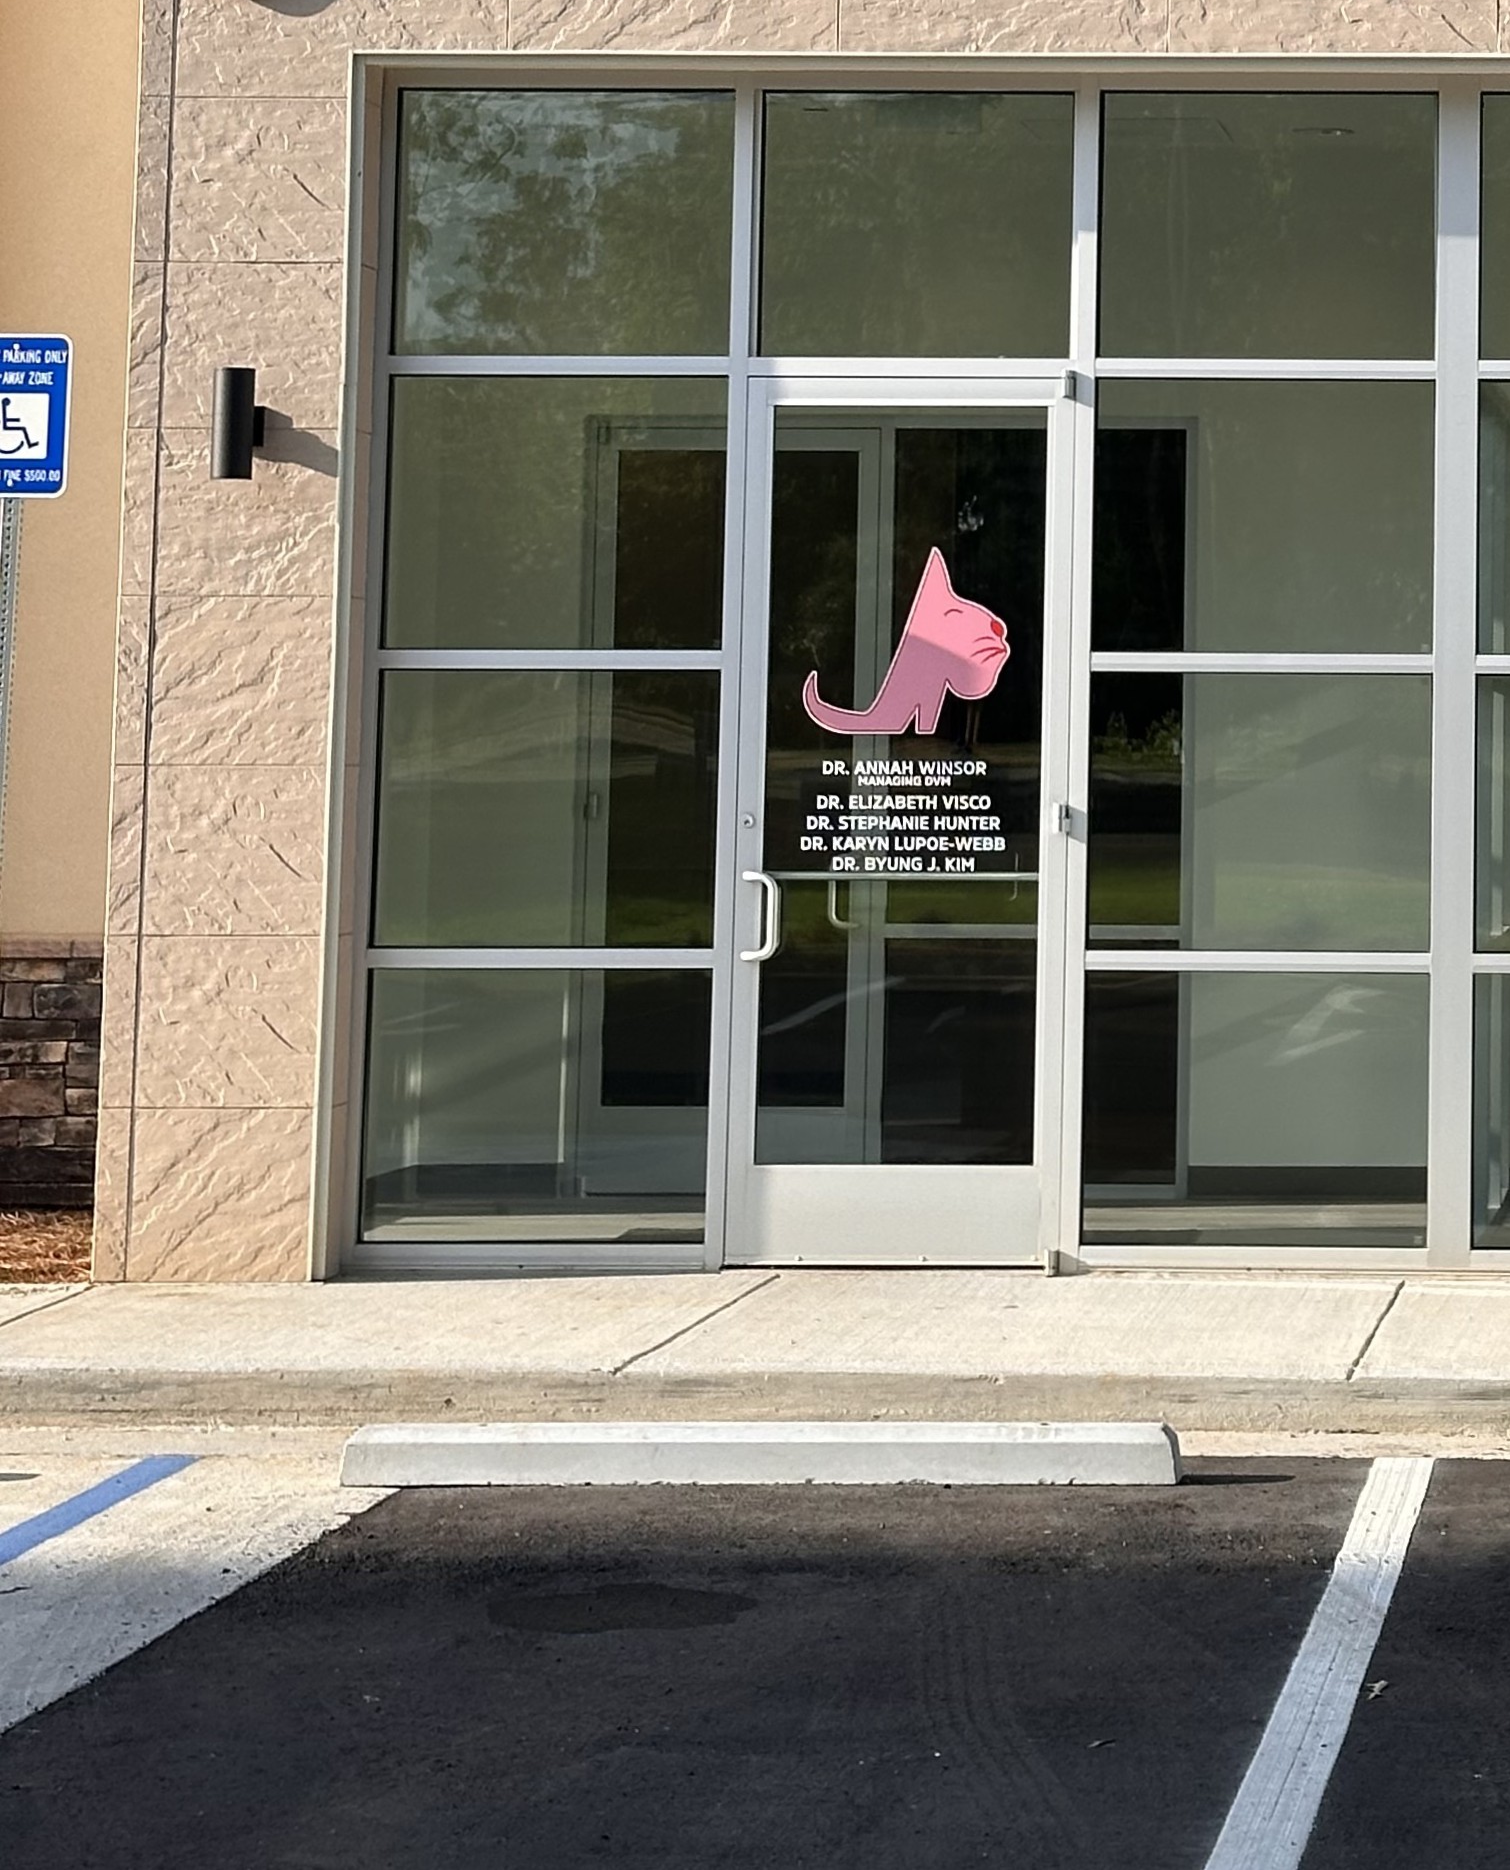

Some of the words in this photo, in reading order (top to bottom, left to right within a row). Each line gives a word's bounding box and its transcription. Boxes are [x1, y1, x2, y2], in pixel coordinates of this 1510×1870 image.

[2, 349, 42, 363] PARKING
[44, 350, 67, 363] ONLY
[28, 371, 54, 385] ZONE
[3, 469, 22, 481] FINE
[24, 469, 61, 482] $500.00
[822, 760, 850, 775] DR.
[854, 760, 913, 775] ANNAH
[919, 760, 987, 776] WINSOR
[858, 776, 922, 786] MANAGING
[925, 776, 950, 786] DVM
[816, 795, 844, 810] DR.
[848, 795, 937, 810] ELIZABETH
[942, 795, 991, 810] VISCO
[806, 816, 834, 830] DR.
[838, 816, 929, 830] STEPHANIE
[934, 816, 1000, 830] HUNTER
[800, 836, 828, 851] DR.
[832, 836, 890, 851] KARYN
[894, 836, 1006, 851] LUPOE-WEBB
[832, 857, 860, 871] DR.
[864, 857, 923, 872] BYUNG
[927, 857, 940, 872] J.
[945, 857, 975, 872] KIM
